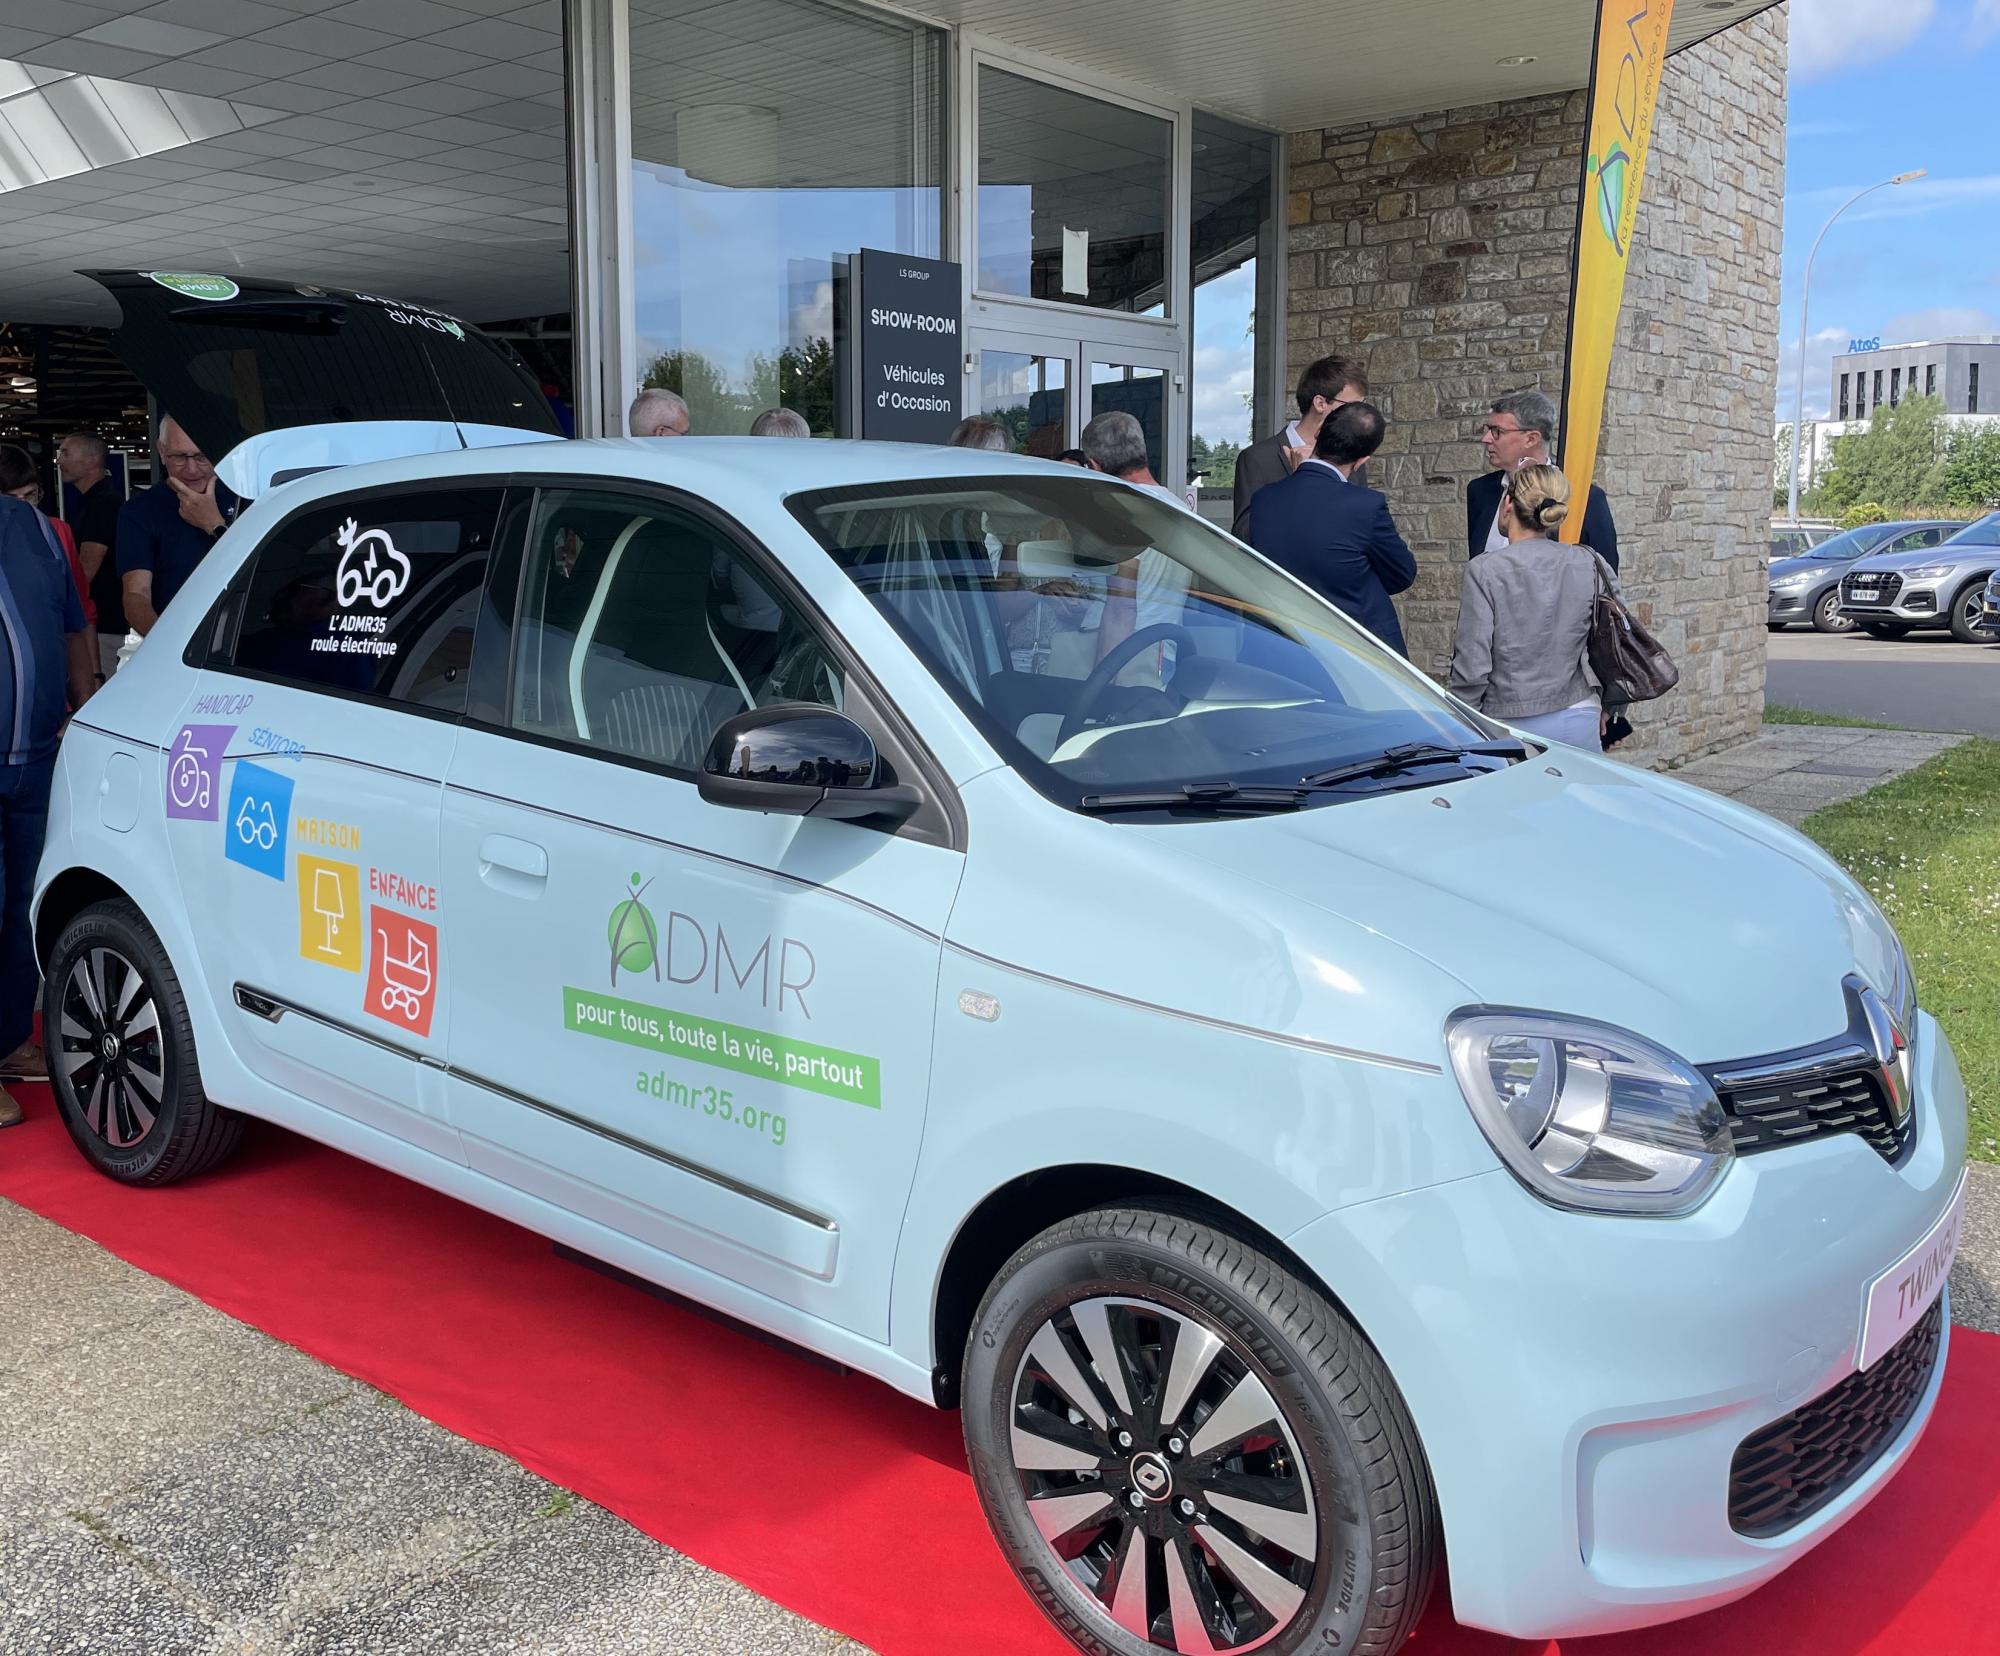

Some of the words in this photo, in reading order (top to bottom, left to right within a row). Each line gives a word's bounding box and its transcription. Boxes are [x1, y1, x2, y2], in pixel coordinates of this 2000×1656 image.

[1640, 107, 1649, 131] du
[899, 268, 907, 278] LS
[908, 270, 930, 281] GROUP
[871, 308, 956, 335] SHOW-ROOM
[883, 364, 945, 386] Véhicules
[891, 392, 951, 412] Occasion
[310, 636, 339, 652] roule
[340, 635, 397, 658] électrique
[192, 694, 254, 715] HANDICAP
[247, 727, 306, 763] SÉNIORS
[296, 816, 360, 850] MAISON
[369, 867, 437, 911] ENFANCE
[608, 873, 816, 1020] ADMR
[576, 1002, 617, 1026] pour
[619, 1008, 664, 1042] tous,
[668, 1020, 717, 1051] toute
[722, 1031, 740, 1058] la
[745, 1039, 780, 1072] vie,
[785, 1052, 863, 1090] partout
[635, 1070, 787, 1146] admr35.org
[1152, 1266, 1287, 1370] MICHELIN
[1339, 1548, 1357, 1614] OUTSIDE
